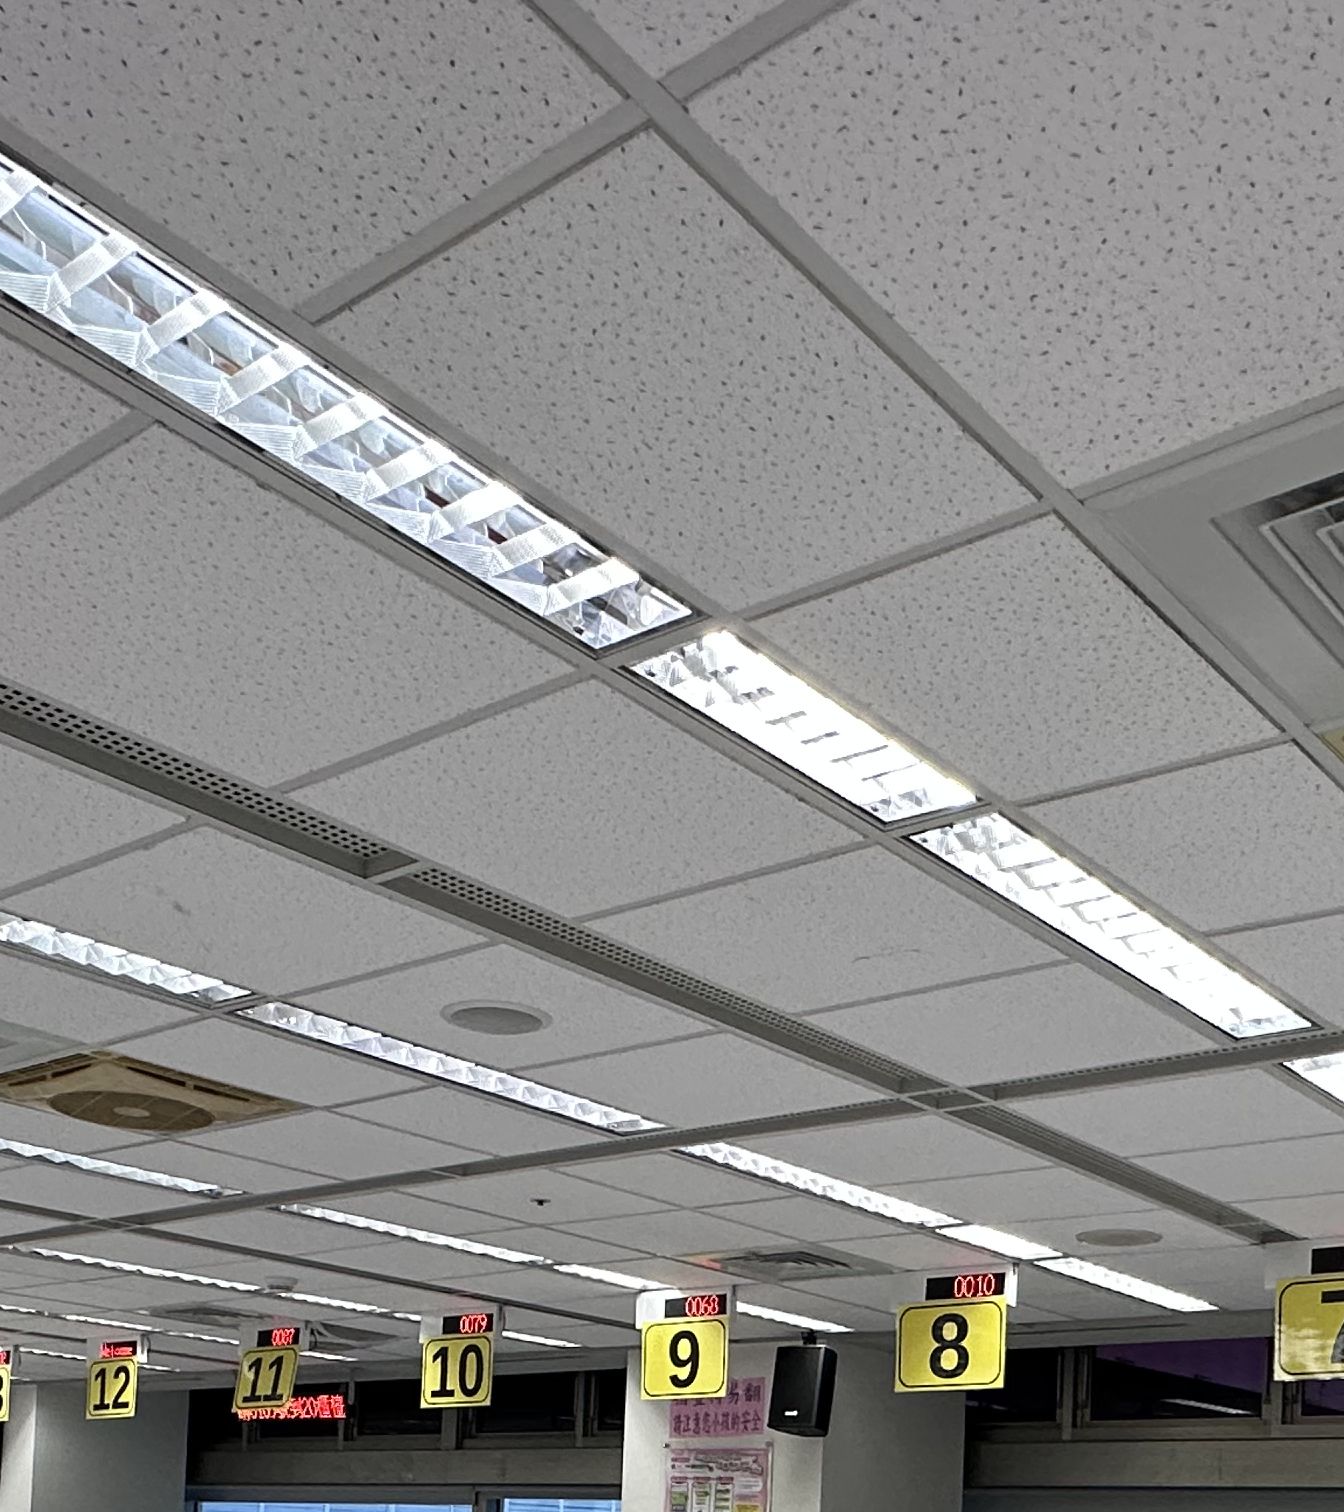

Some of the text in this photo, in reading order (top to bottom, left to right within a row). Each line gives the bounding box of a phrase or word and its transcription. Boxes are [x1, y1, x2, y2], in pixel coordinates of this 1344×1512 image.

[685, 1294, 719, 1316] 0068
[954, 1274, 995, 1298] 0010
[459, 1313, 488, 1333] 0079
[928, 1312, 970, 1378] 8
[242, 1355, 285, 1404] 11
[430, 1344, 484, 1398] 10
[669, 1330, 700, 1388] 9
[92, 1365, 130, 1411] 12
